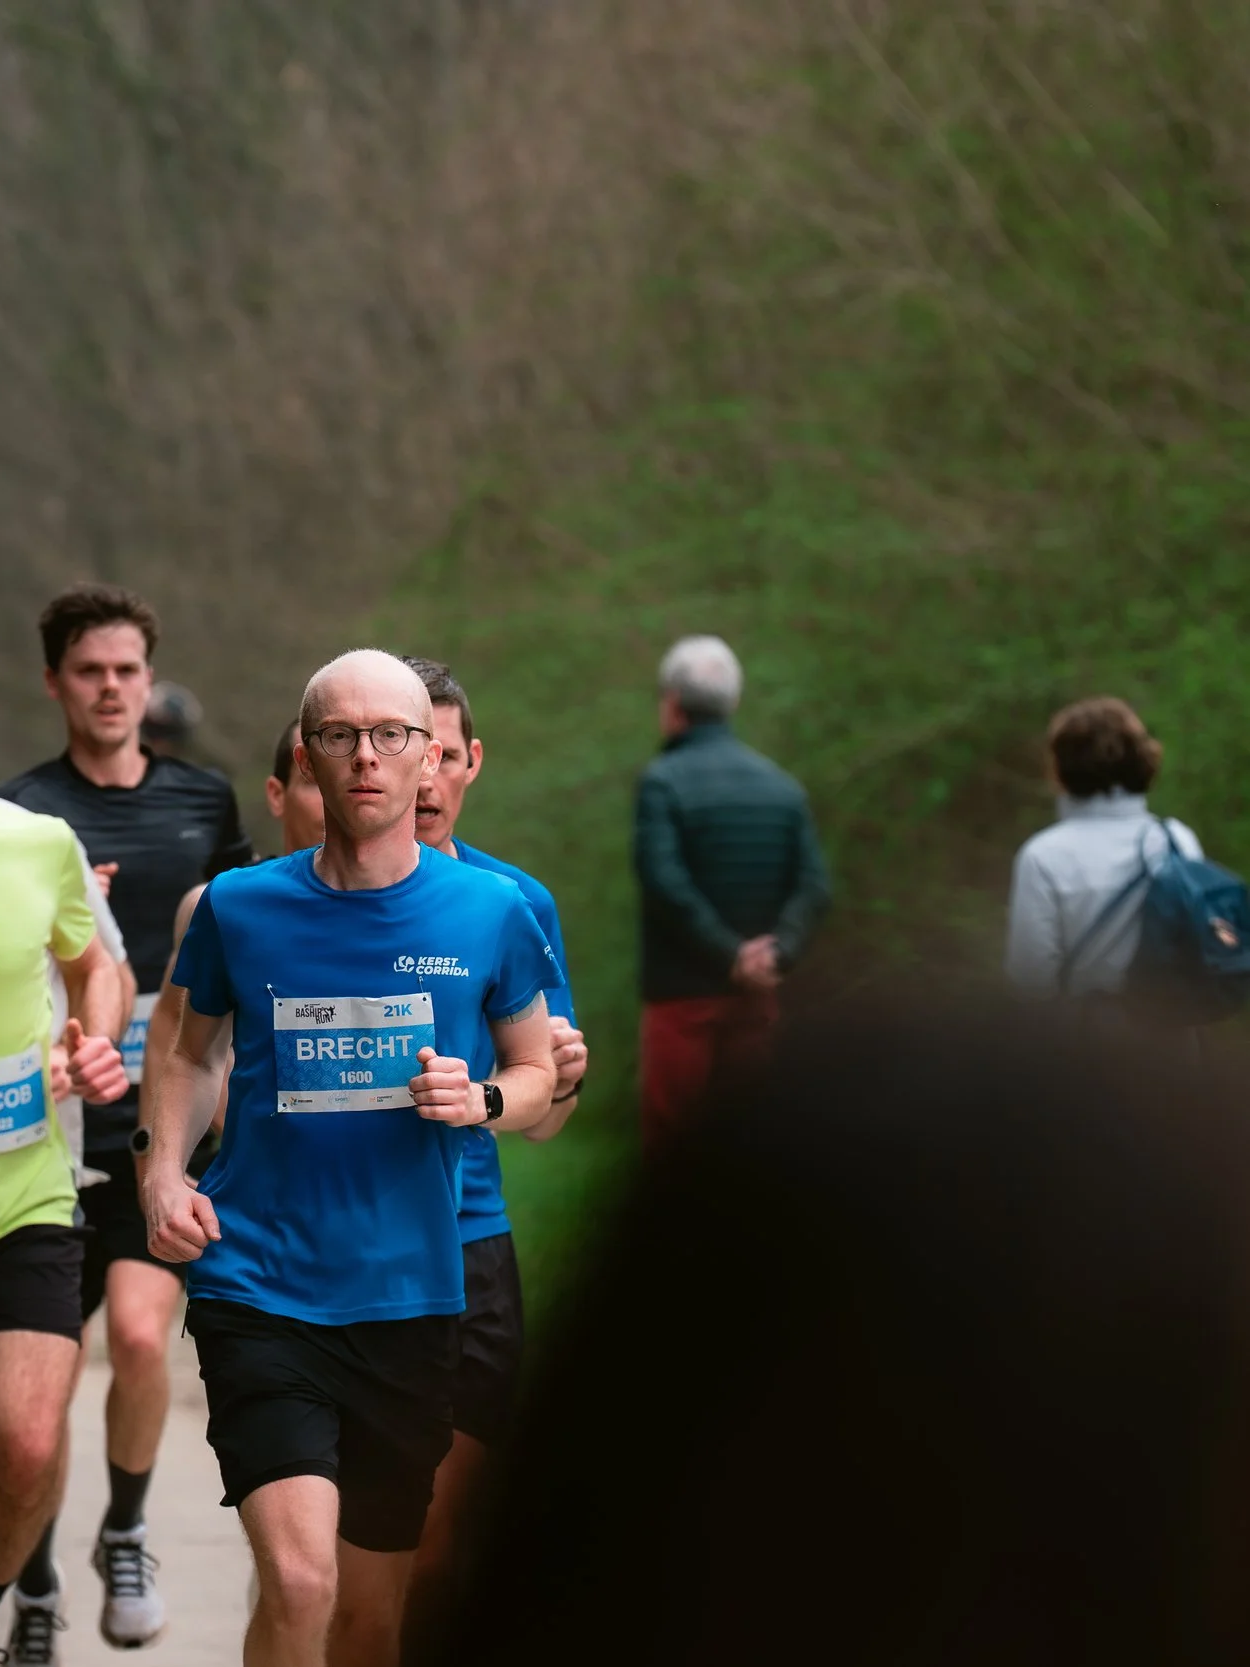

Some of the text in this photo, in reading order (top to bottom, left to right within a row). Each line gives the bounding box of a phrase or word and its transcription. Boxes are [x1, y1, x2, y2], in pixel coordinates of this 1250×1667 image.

[417, 956, 459, 967] KERST
[415, 965, 469, 977] CORRIDA
[383, 1003, 414, 1018] 21K
[296, 1034, 415, 1061] BRECHT
[339, 1070, 374, 1084] 1600
